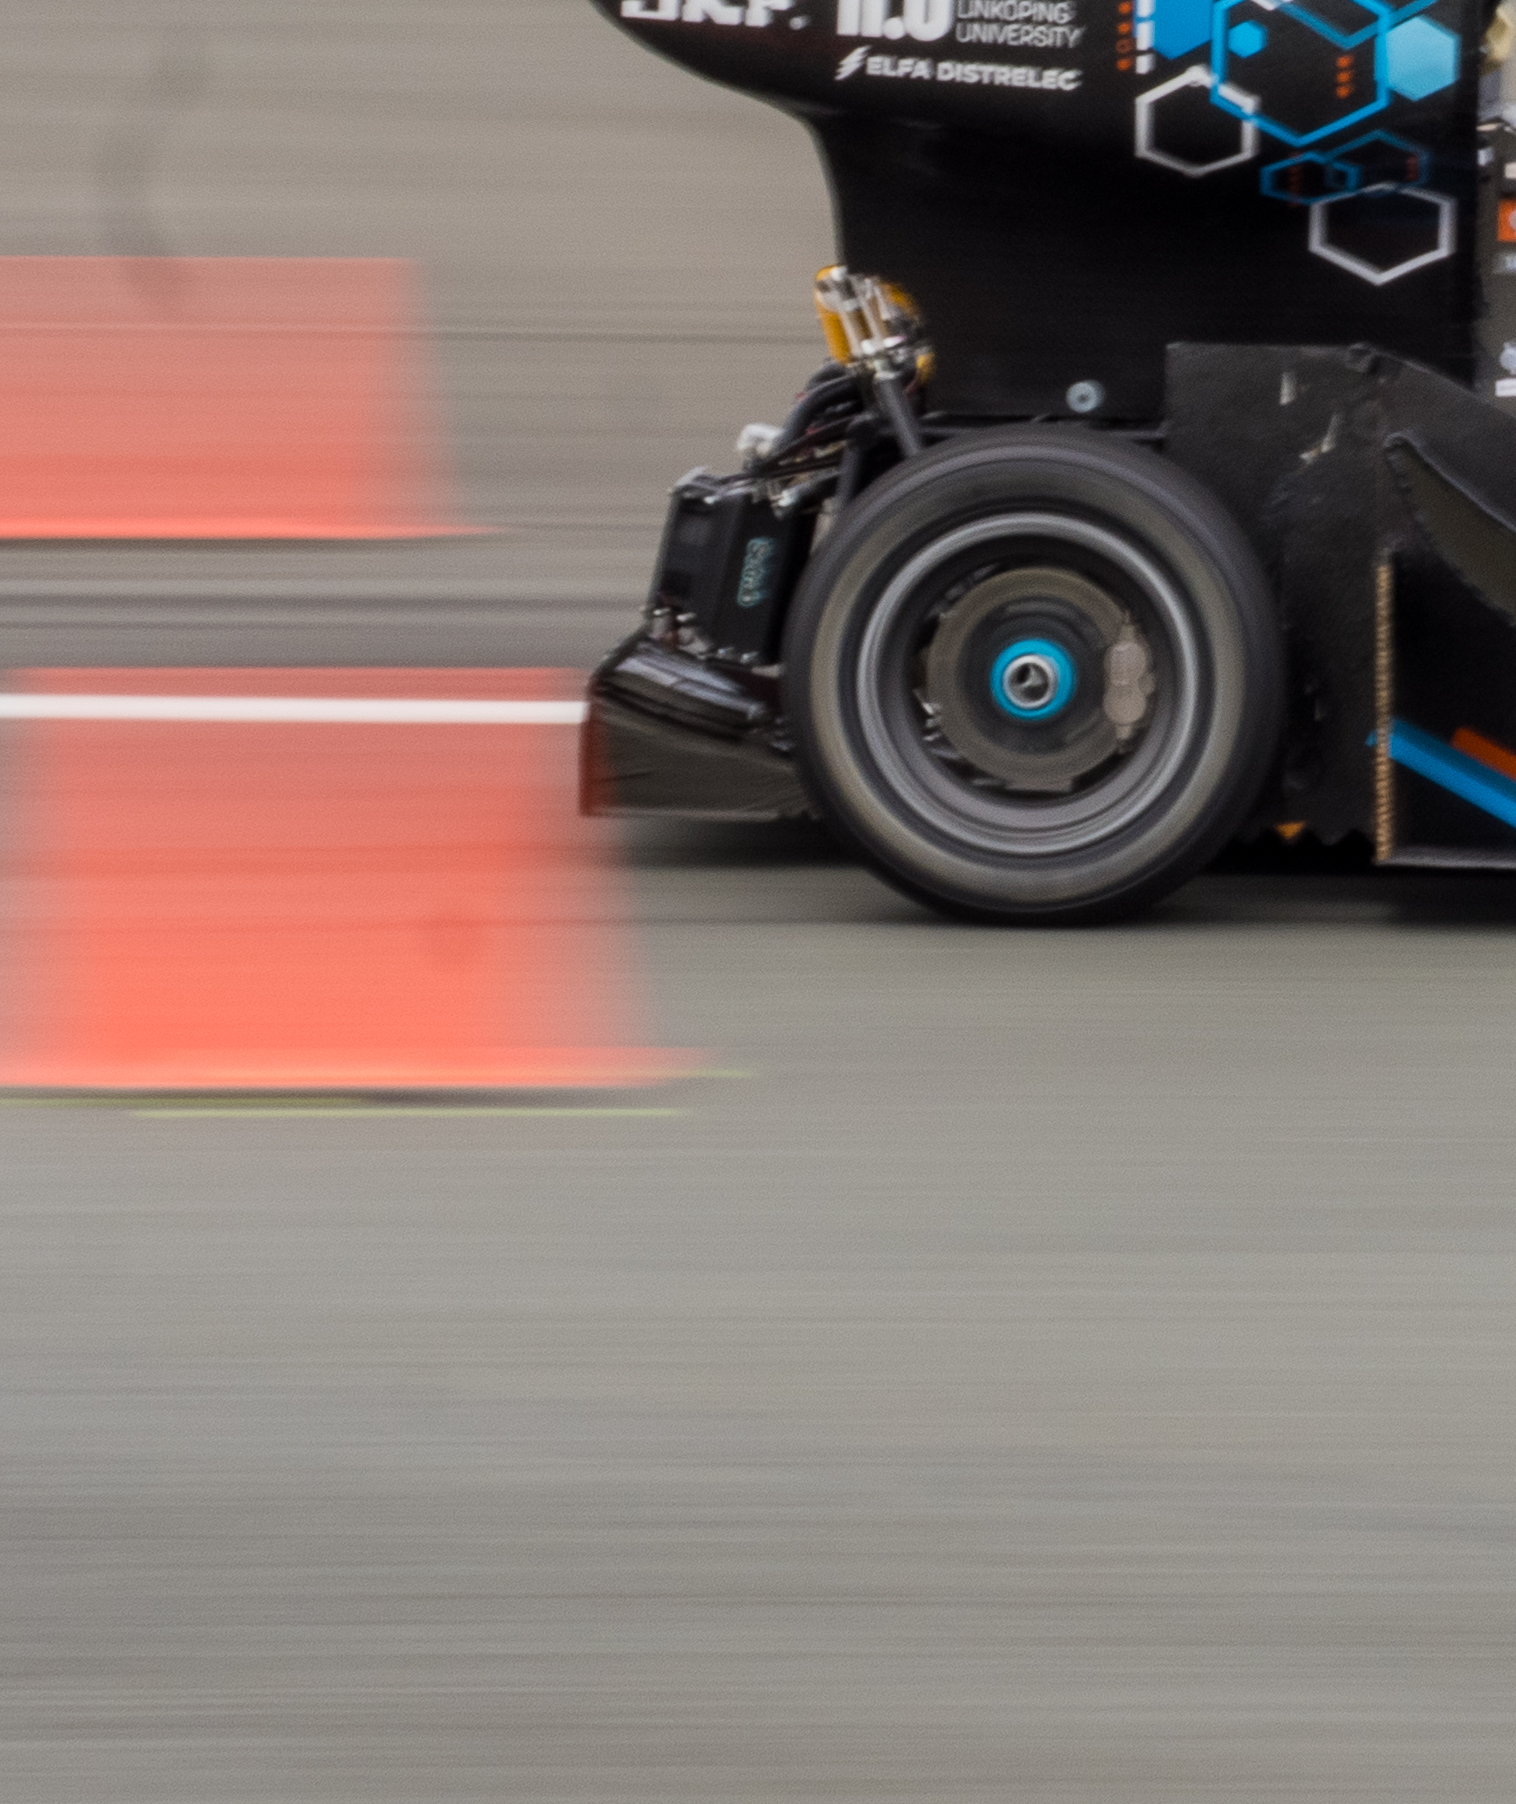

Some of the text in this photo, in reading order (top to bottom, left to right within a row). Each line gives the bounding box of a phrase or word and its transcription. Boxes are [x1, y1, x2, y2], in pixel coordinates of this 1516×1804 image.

[955, 24, 1084, 48] UNIVERSITY
[866, 55, 1083, 91] ELFA DISTRELEC
